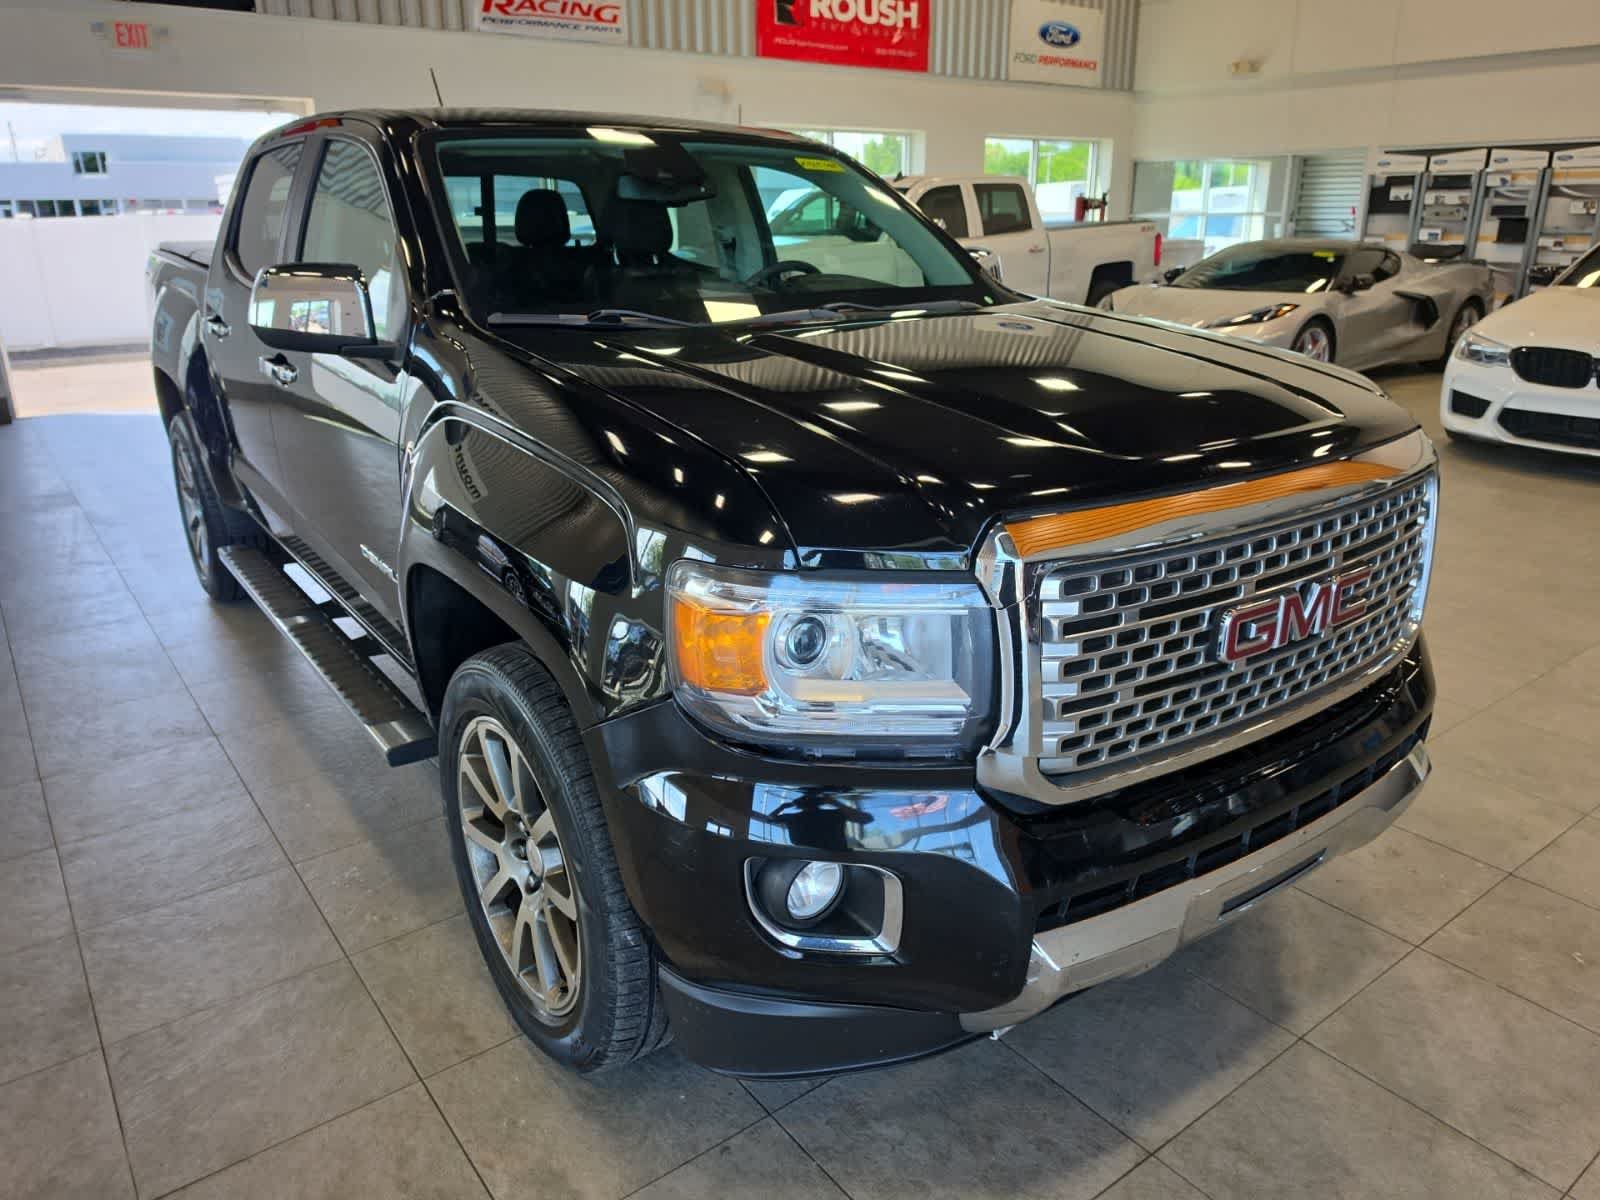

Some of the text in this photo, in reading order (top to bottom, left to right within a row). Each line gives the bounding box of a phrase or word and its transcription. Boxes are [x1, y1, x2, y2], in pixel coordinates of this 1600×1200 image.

[482, 0, 621, 24] RACING
[810, 0, 918, 29] ROUSH
[114, 22, 148, 48] EXIT
[1046, 24, 1074, 44] Ford
[1217, 564, 1374, 663] GMC
